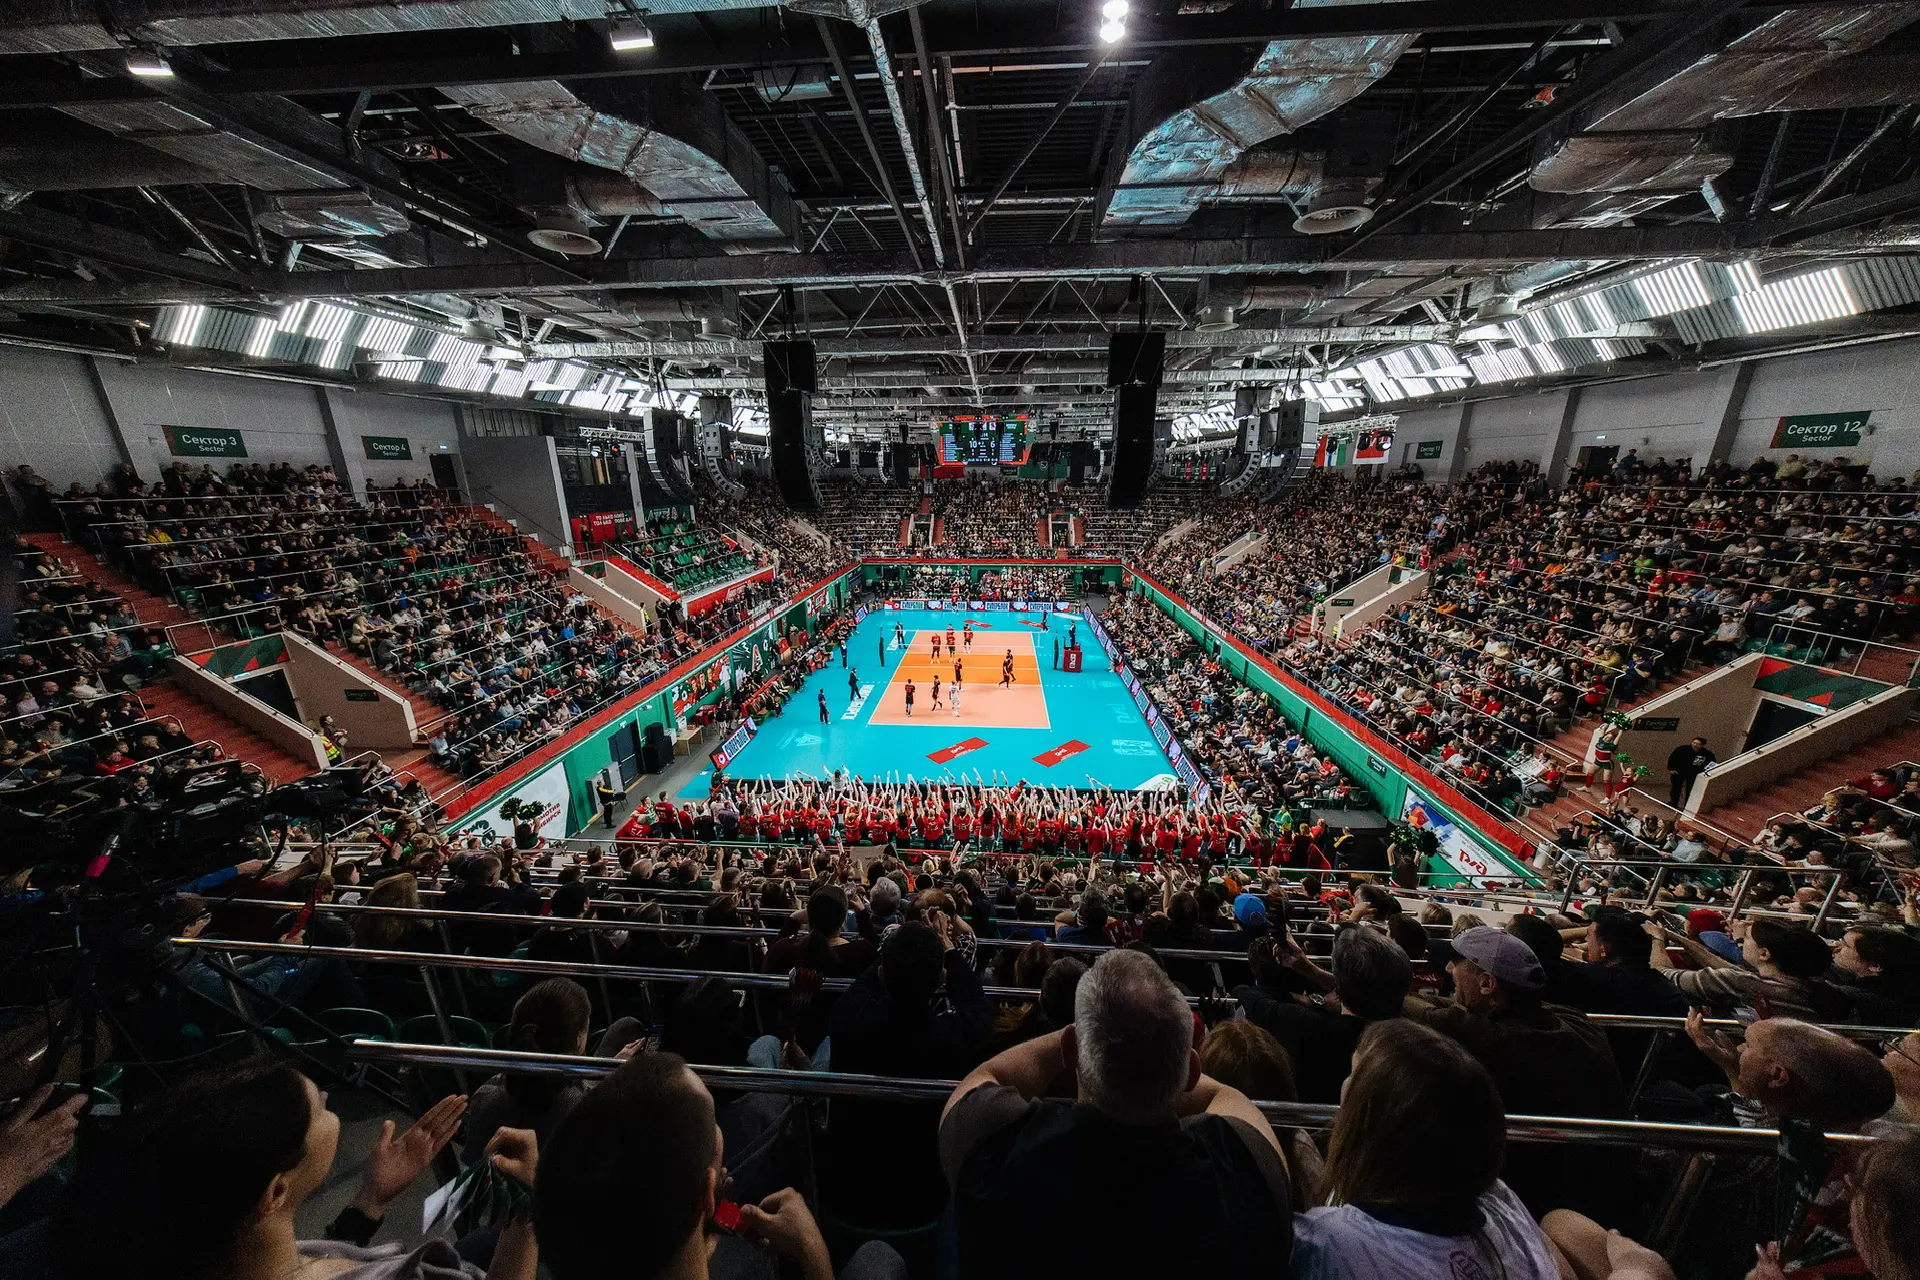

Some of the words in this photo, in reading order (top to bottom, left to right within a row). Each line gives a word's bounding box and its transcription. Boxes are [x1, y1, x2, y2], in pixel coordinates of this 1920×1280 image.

[1787, 424, 1837, 435] Сектор
[1843, 420, 1861, 432] 12
[182, 434, 227, 446] Сектор
[229, 437, 237, 446] 3
[969, 440, 977, 448] 10
[990, 440, 996, 448] 6
[372, 442, 400, 451] Сектор
